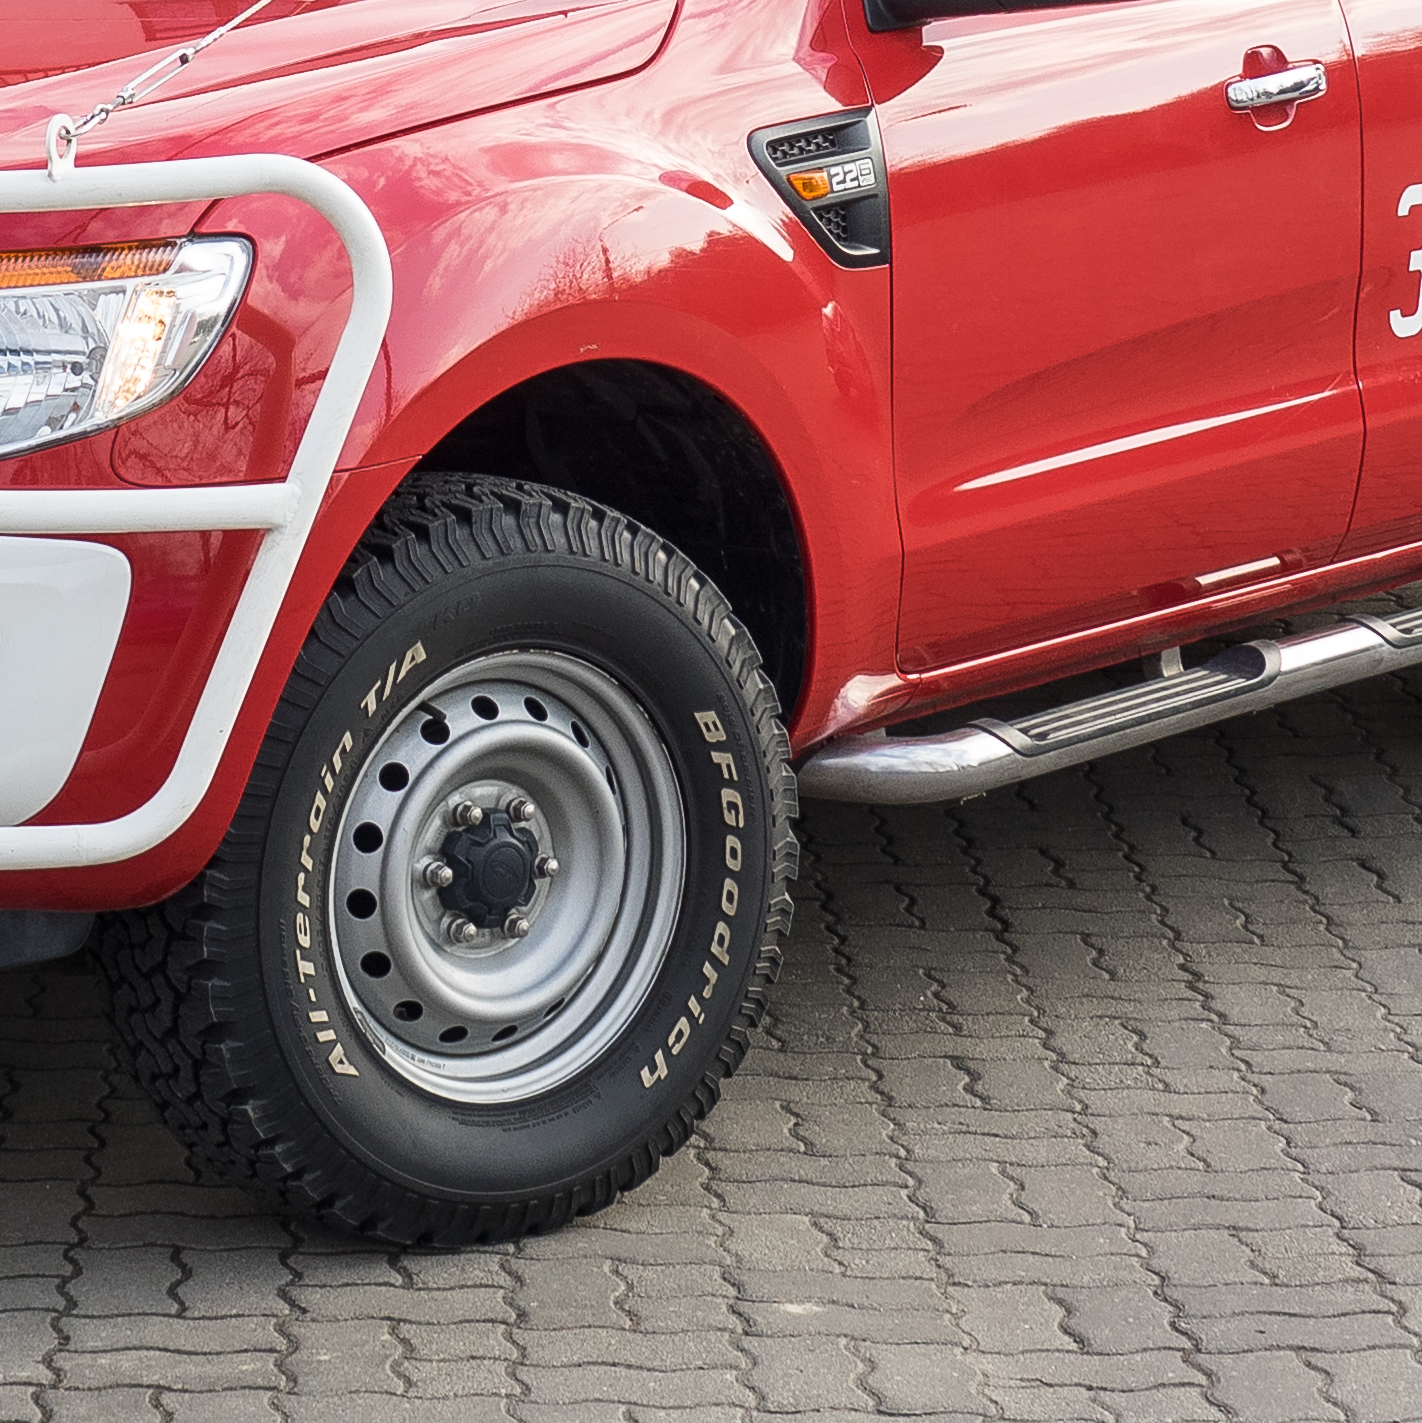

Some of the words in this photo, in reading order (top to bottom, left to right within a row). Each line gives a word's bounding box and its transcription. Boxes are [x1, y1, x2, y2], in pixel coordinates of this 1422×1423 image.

[294, 730, 361, 1078] All-Terrain
[360, 639, 427, 720] T/A
[639, 709, 745, 1089] BFGoodrich
